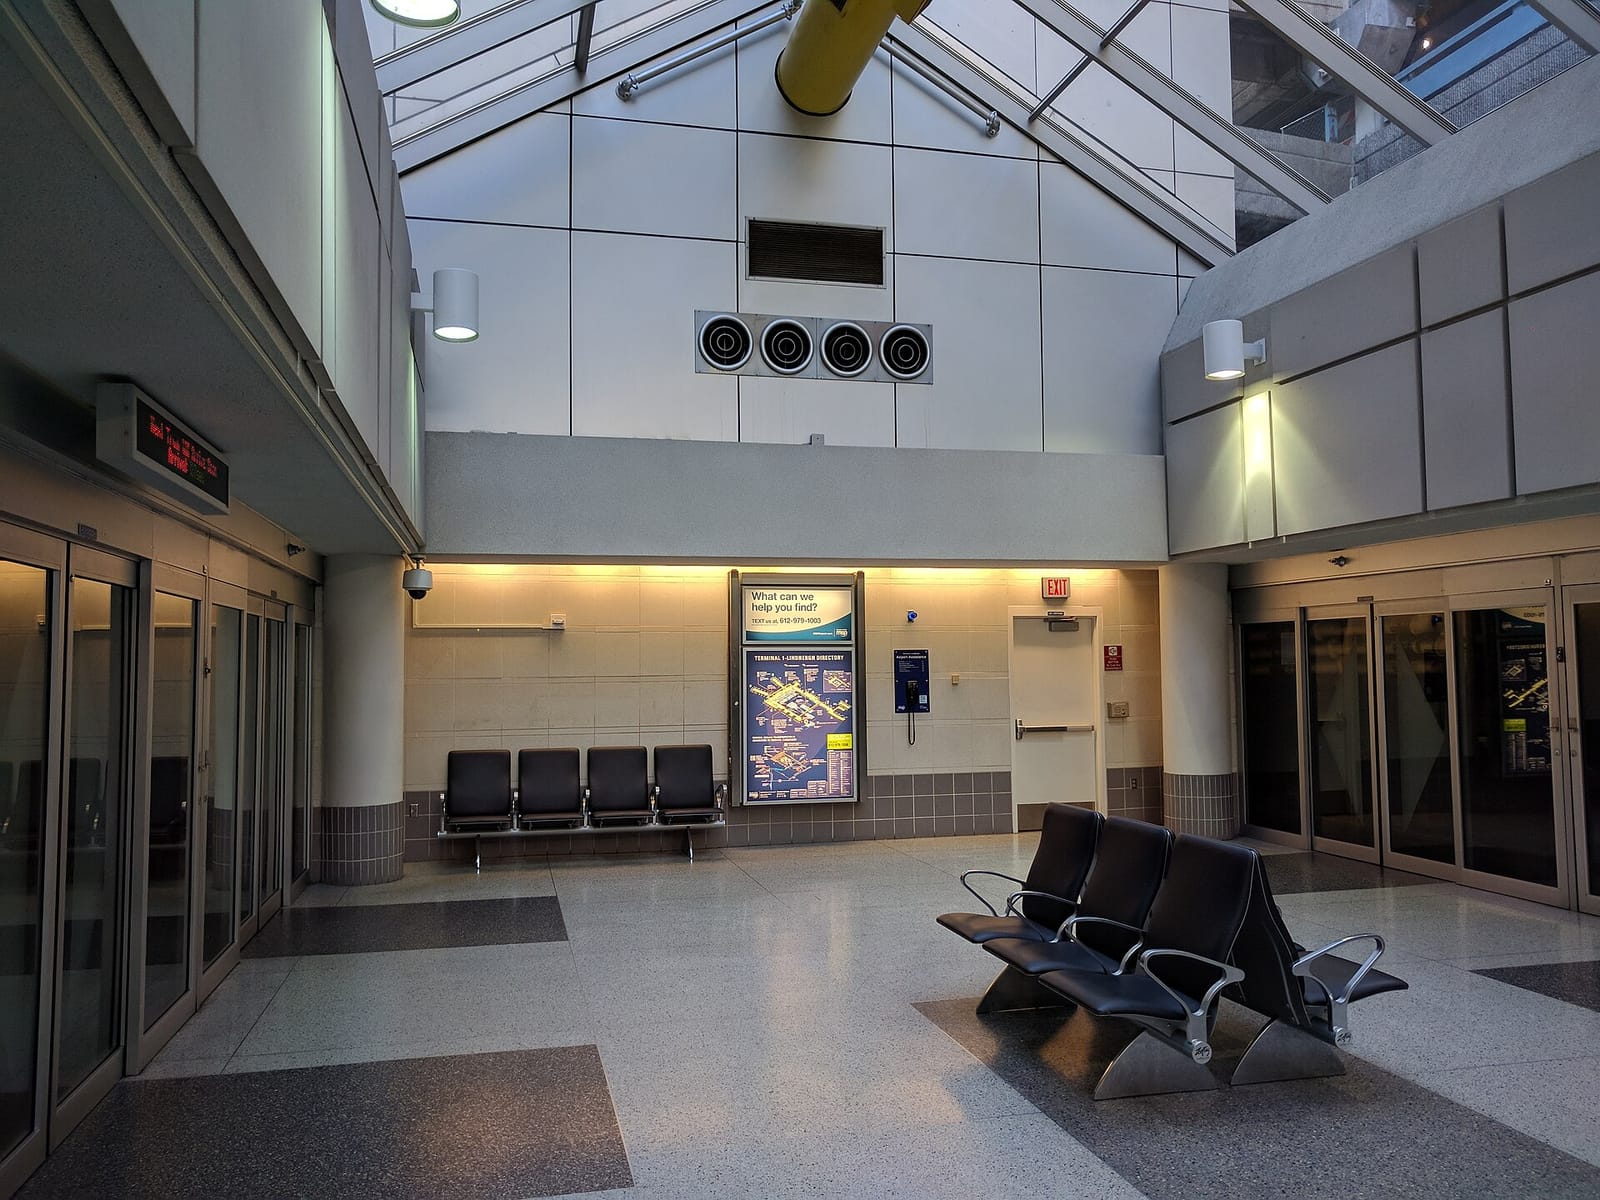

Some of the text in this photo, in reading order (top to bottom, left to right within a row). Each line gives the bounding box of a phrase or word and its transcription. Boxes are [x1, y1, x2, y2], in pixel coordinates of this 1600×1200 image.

[1047, 579, 1067, 595] EXIT
[751, 591, 777, 601] What
[780, 593, 798, 601] can
[751, 602, 818, 613] help you find?
